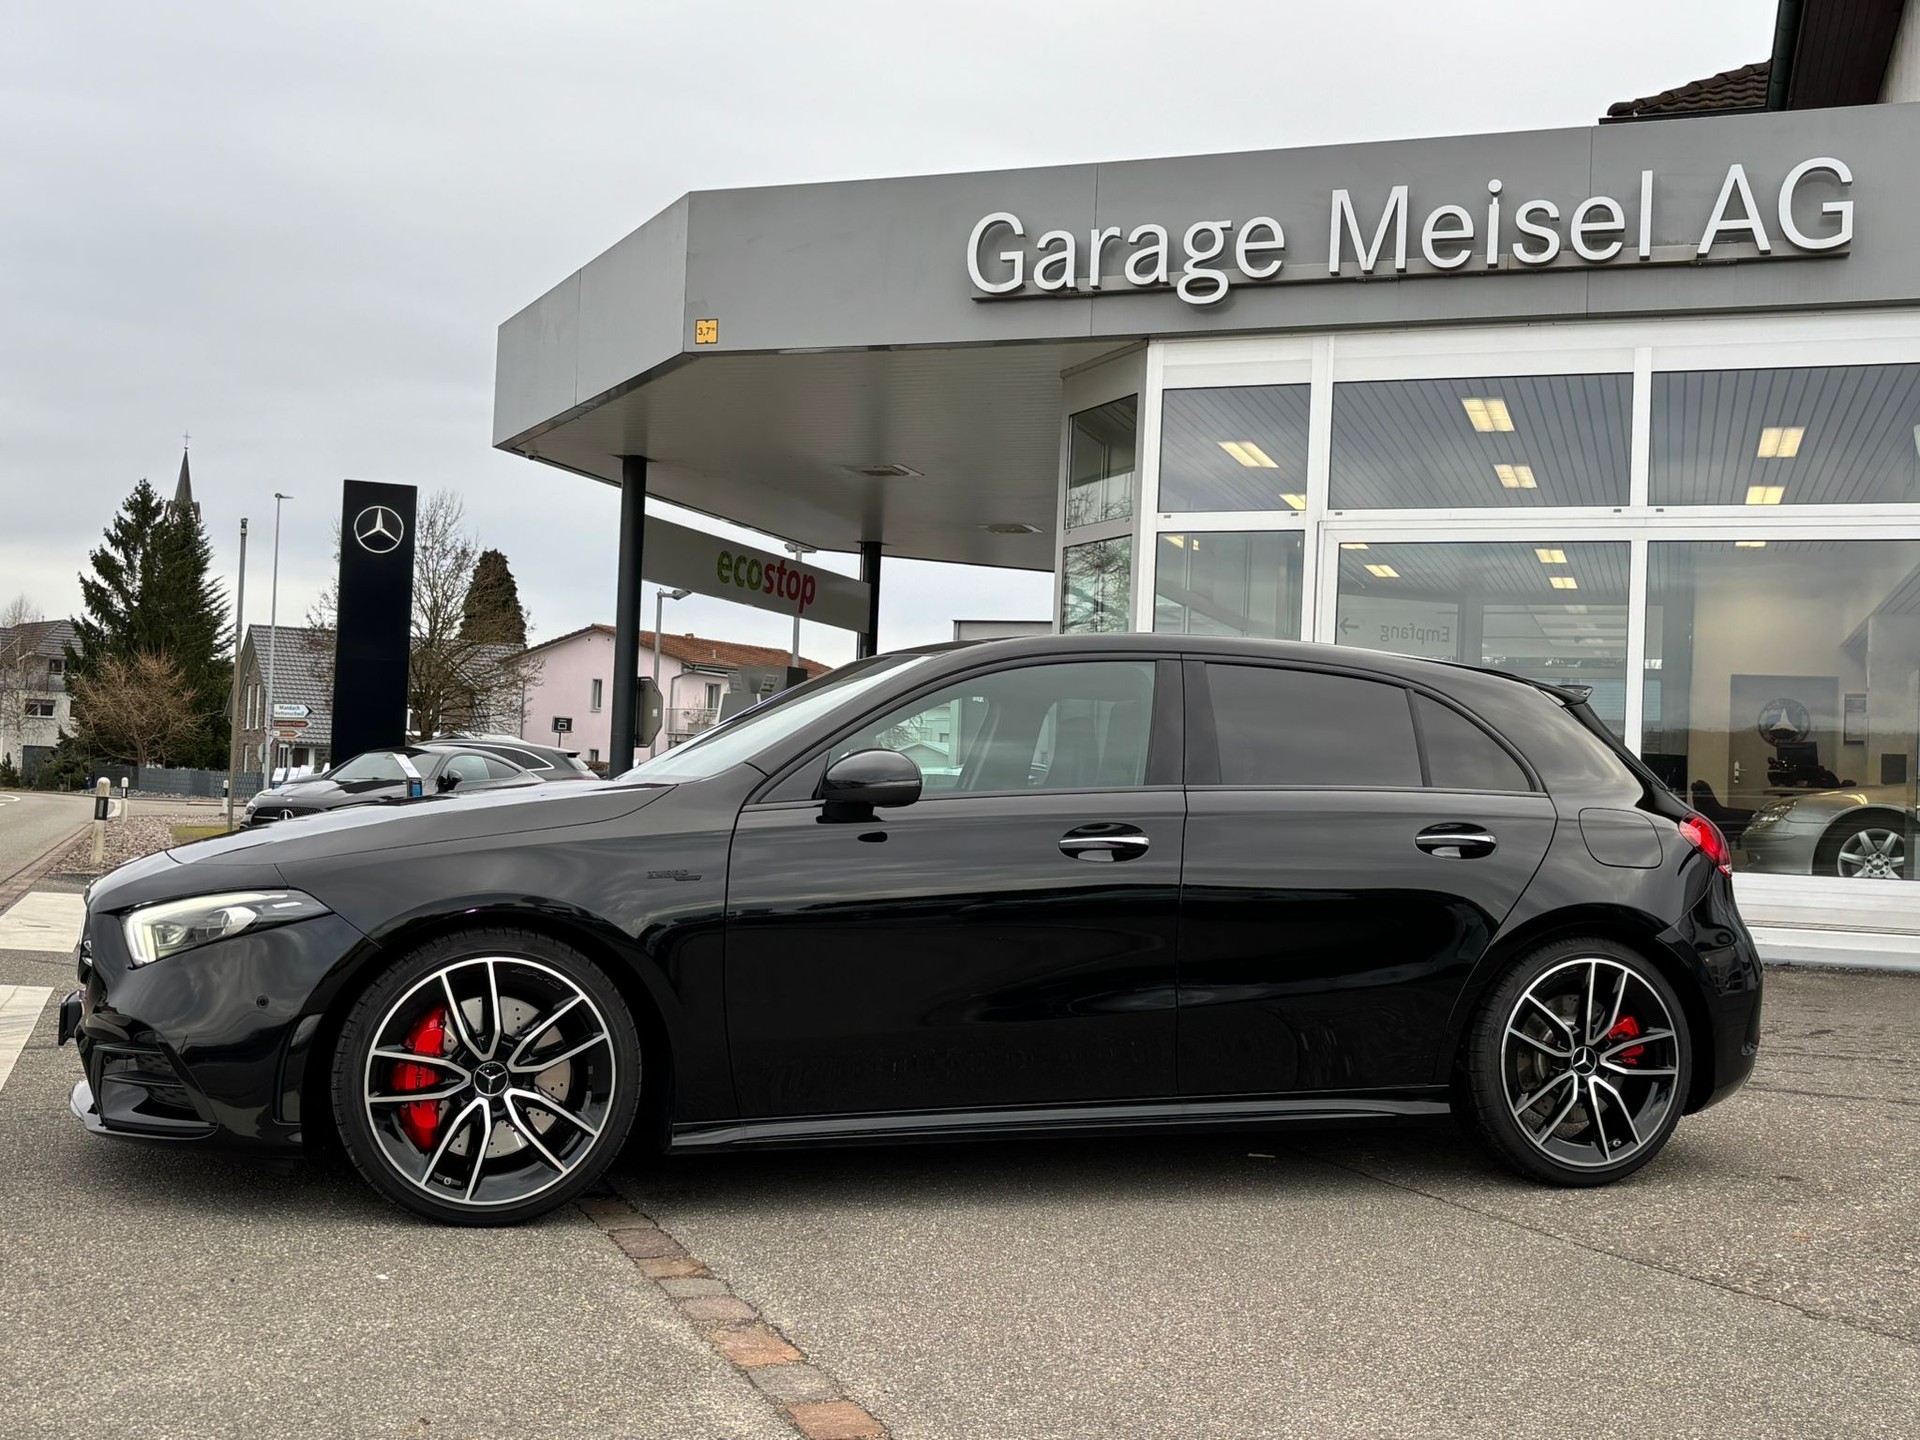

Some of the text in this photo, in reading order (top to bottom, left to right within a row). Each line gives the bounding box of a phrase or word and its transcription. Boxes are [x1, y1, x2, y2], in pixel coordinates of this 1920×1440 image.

[966, 157, 1854, 304] Garage Meisel AG
[717, 550, 816, 613] ecostop
